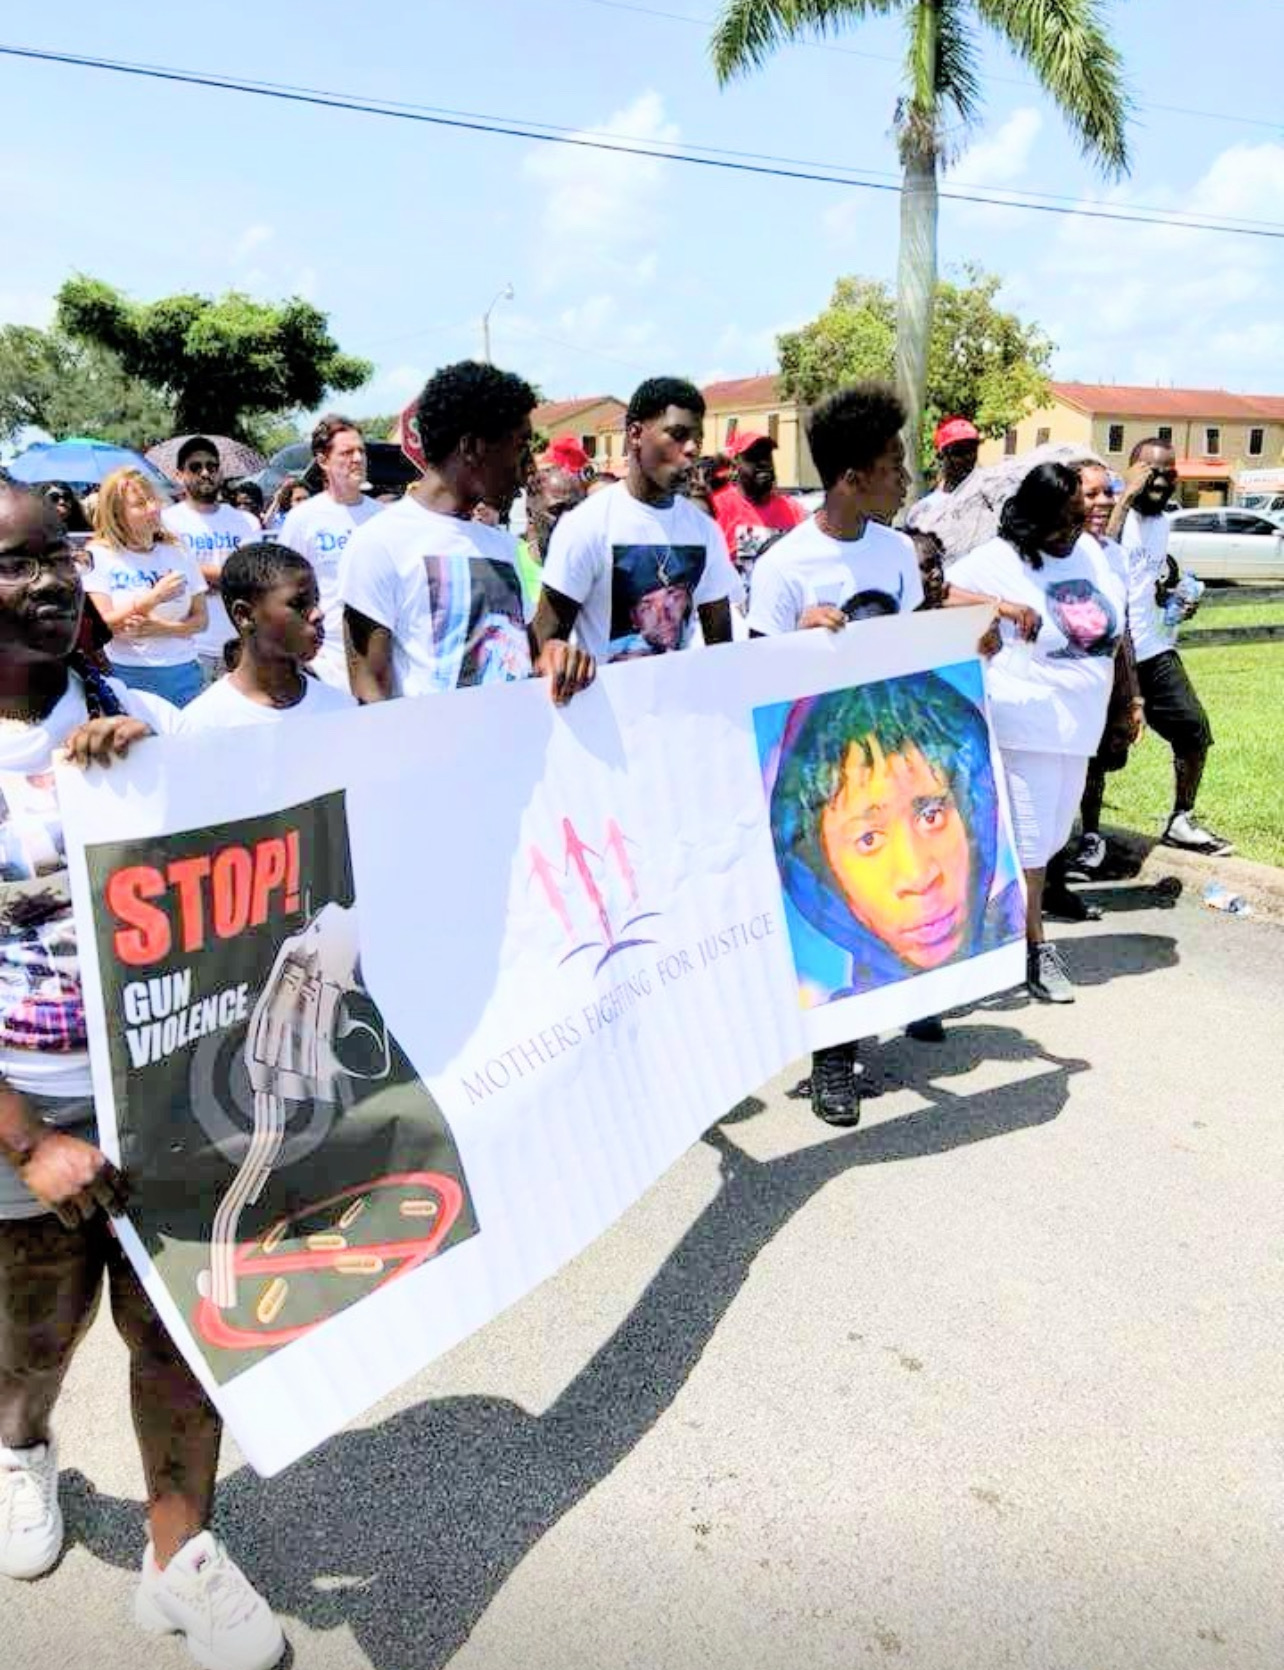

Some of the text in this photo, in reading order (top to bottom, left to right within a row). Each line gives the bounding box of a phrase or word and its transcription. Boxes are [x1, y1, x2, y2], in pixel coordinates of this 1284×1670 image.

[107, 830, 300, 966] STOP!
[122, 969, 192, 1025] GUN
[124, 983, 249, 1068] VIOLENCE
[459, 1015, 583, 1106] MOTHERS
[656, 949, 694, 986] FOR
[697, 912, 775, 968] JUSTICE
